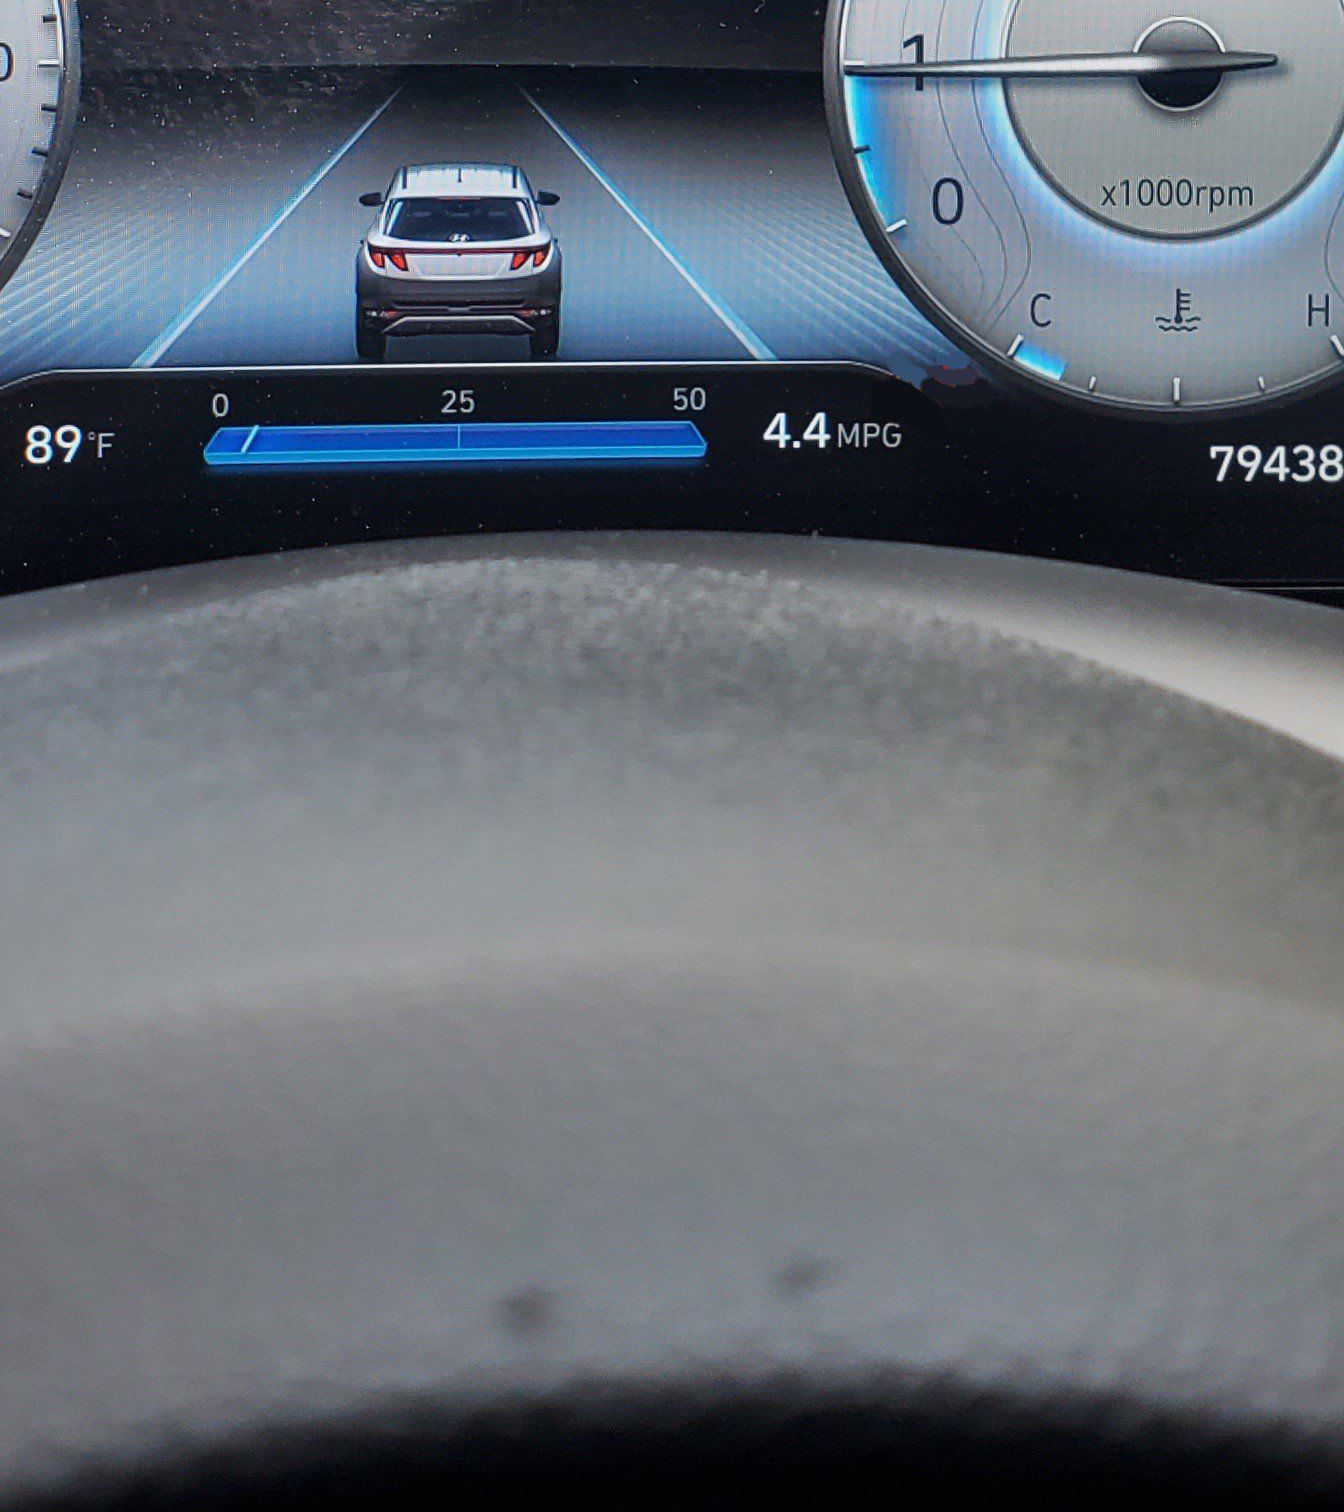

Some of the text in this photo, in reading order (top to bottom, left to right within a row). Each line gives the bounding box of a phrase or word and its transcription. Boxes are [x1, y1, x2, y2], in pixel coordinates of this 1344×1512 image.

[901, 33, 927, 92] 1
[931, 177, 965, 225] 0
[1101, 177, 1255, 211] x1000rpm
[1029, 293, 1052, 328] C
[1307, 293, 1332, 328] H
[211, 392, 229, 420] 0
[440, 389, 475, 415] 25
[672, 386, 707, 412] 50
[25, 423, 82, 465] 89
[762, 411, 903, 450] 4.4 MPG
[1209, 444, 1344, 485] 79438
